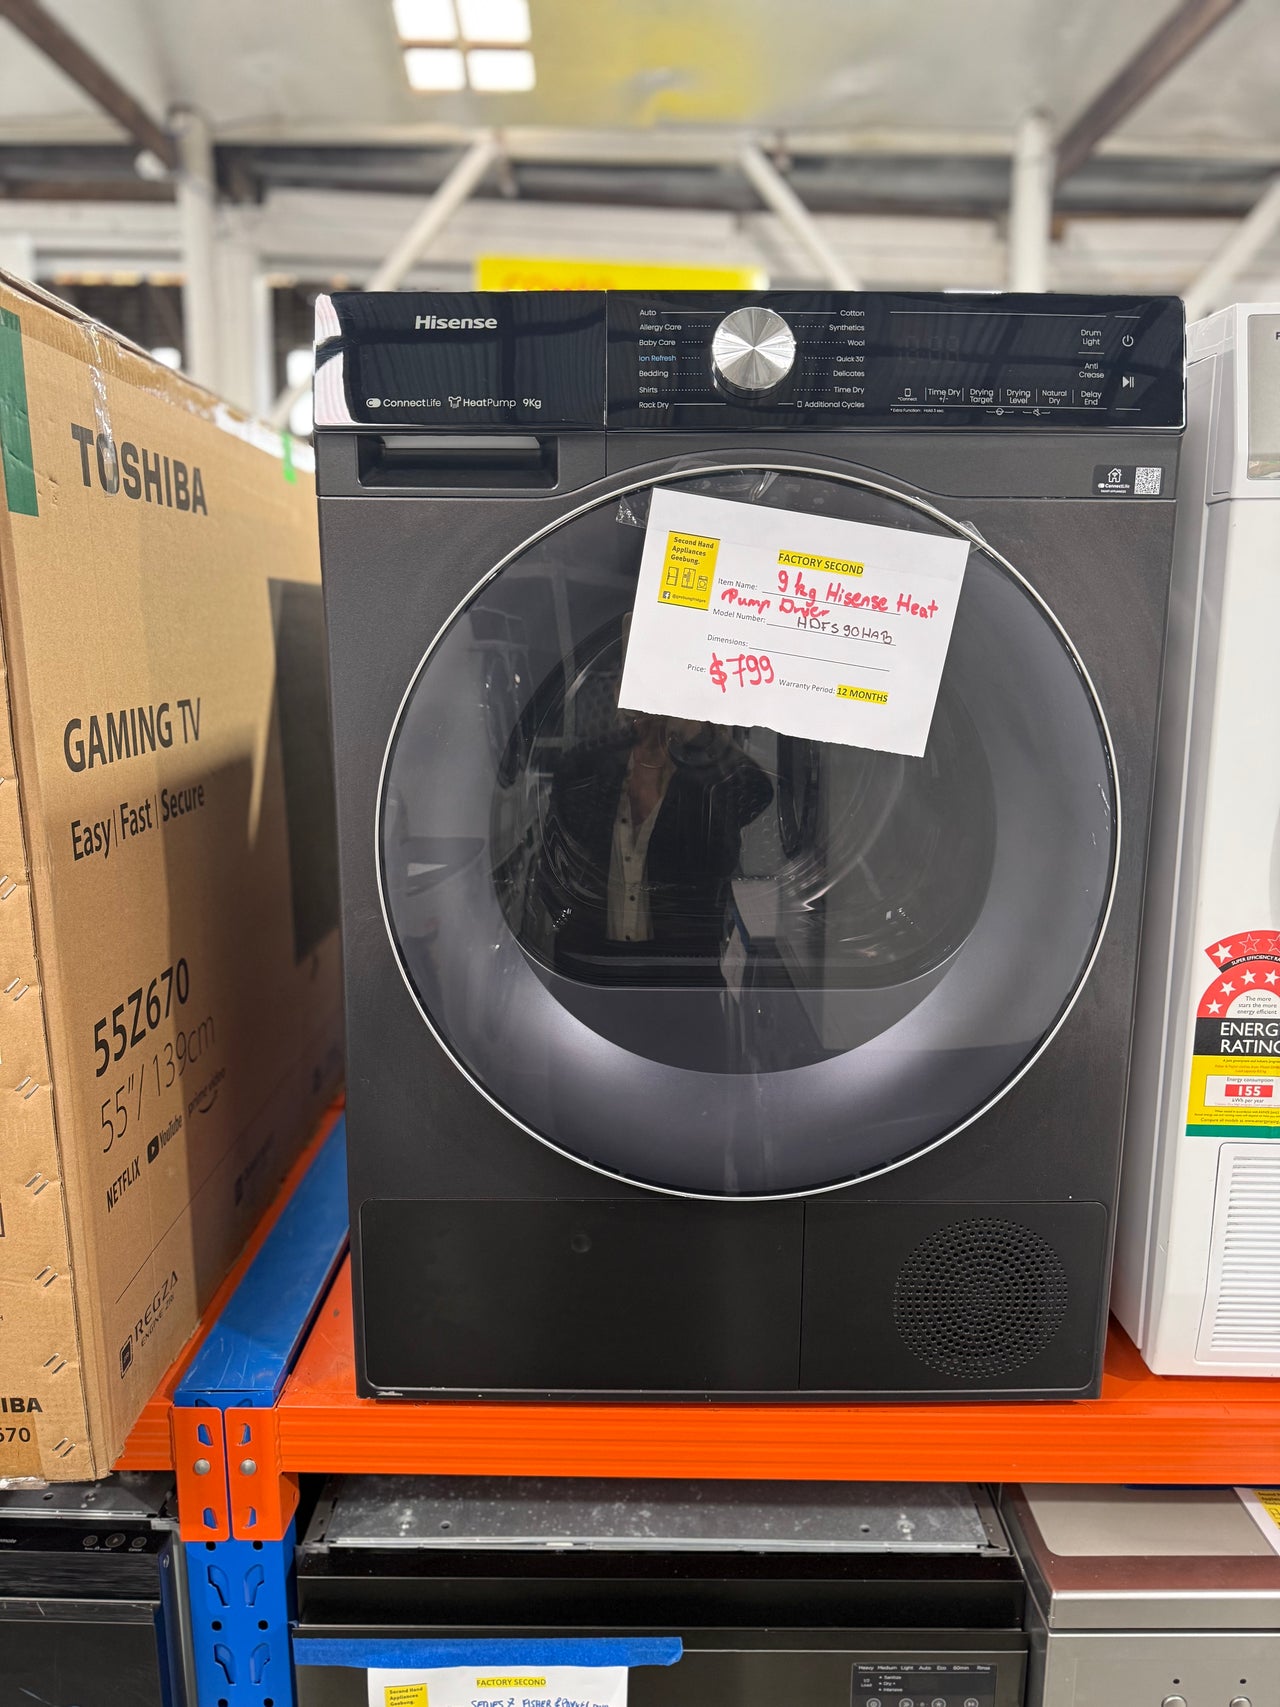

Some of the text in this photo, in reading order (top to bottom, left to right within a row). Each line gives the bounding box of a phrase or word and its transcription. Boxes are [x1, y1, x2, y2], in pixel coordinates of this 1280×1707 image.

[839, 309, 865, 317] Cotton
[414, 315, 498, 330] Hisense
[639, 323, 682, 332] Allergy Care
[829, 324, 865, 332] Synthetics
[1080, 329, 1102, 337] Drum
[638, 339, 658, 347] Baby
[1082, 338, 1100, 346] Light
[836, 355, 855, 363] Quick
[638, 370, 669, 378] Bedding
[638, 386, 658, 394] Shirts
[852, 386, 865, 395] Dry
[928, 388, 961, 397] Time Dry
[969, 388, 994, 397] Drying
[1006, 389, 1031, 398] Drying
[1080, 390, 1102, 399] Delay
[382, 397, 442, 409] ConnectLife
[462, 397, 517, 409] HeatPump
[522, 398, 542, 410] 9Kg
[656, 401, 669, 410] Dry
[841, 401, 865, 409] Cycles
[969, 396, 993, 404] Target
[1048, 397, 1061, 405] Dry
[71, 422, 208, 516] TOSHIBA
[673, 536, 715, 549] Second Hand
[671, 545, 707, 556] Appliances
[670, 554, 700, 565] Geebung.
[778, 552, 864, 575] FACTORY SECOND
[718, 570, 940, 620] Item Name: 9 kg Hisense Heat
[720, 588, 771, 614] Pump
[713, 608, 735, 618] Model
[736, 611, 766, 624] Number:
[707, 634, 749, 647] Dimensions:
[687, 652, 775, 693] Price: $799
[778, 678, 889, 703] Warranty Period: 12 MONTHS
[63, 696, 202, 773] GAMING TV
[71, 784, 205, 861] Easy Fast Secure
[1231, 956, 1247, 965] SUPER
[93, 957, 190, 1078] 55Z670
[1220, 1021, 1279, 1037] ENERG
[152, 1015, 215, 1097] 139cm
[1238, 1085, 1262, 1097] 155
[107, 1155, 141, 1213] NETFLIX
[159, 1113, 183, 1149] YouTube
[187, 1086, 208, 1118] prime
[134, 1270, 178, 1342] REGZA
[141, 1307, 164, 1347] ENGINE
[1, 1397, 43, 1413] IBA
[513, 1678, 546, 1686] SECOND
[389, 1693, 418, 1701] Appliances
